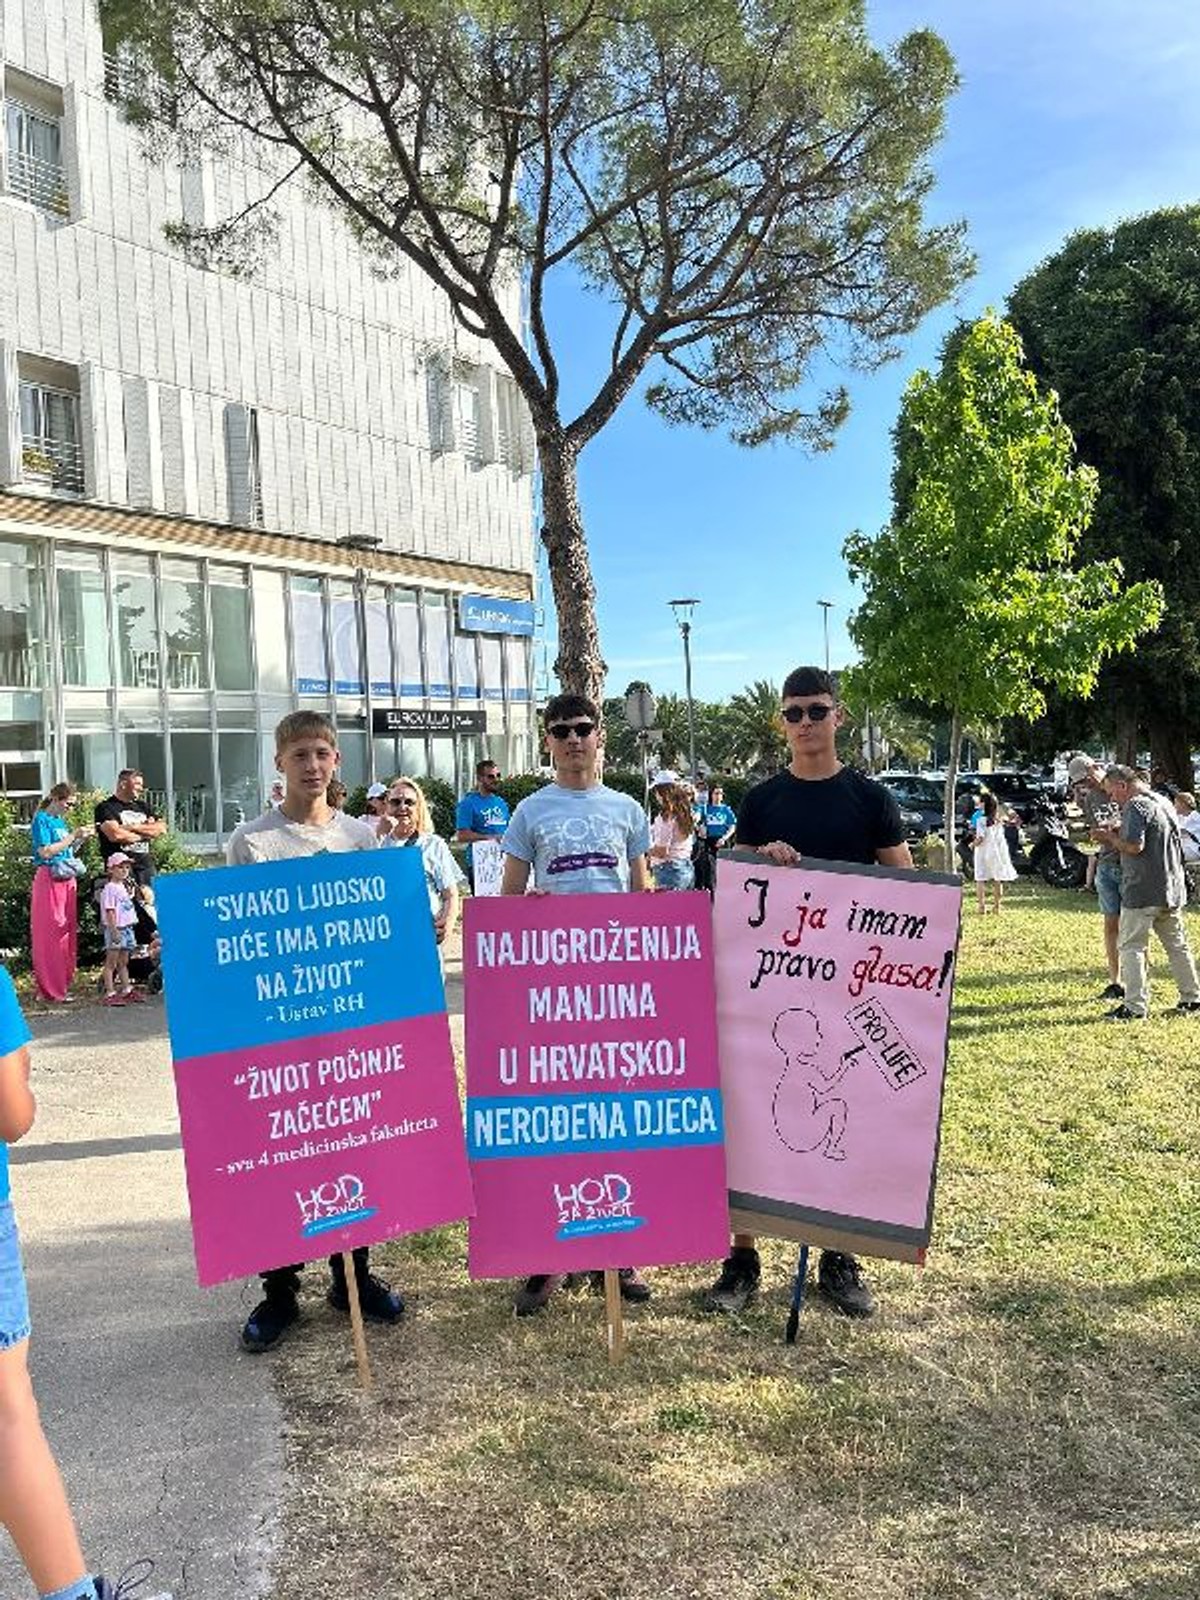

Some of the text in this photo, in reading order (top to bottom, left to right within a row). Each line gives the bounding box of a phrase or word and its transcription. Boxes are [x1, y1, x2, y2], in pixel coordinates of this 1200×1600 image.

[297, 875, 386, 911] LJUDSKO
[216, 914, 391, 965] BIĆE IMA PRAVO
[782, 891, 828, 947] ja
[847, 900, 928, 940] imam
[476, 920, 702, 967] NAJUGROŽENIJA
[256, 972, 287, 1001] NA
[750, 945, 954, 998] pravo glasa!
[277, 1002, 330, 1023] Ustav
[333, 992, 365, 1014] RH
[528, 982, 658, 1024] MANJINA
[318, 1043, 405, 1086] POČINJE
[499, 1038, 687, 1085] U HRVATSKOJ
[854, 1005, 919, 1085] PRO-LIFE
[258, 1153, 269, 1167] 4
[272, 1132, 367, 1165] medicinska
[370, 1117, 438, 1142] fakulteta
[473, 1096, 718, 1148] NEROĐENA DJECA
[295, 1174, 364, 1214] HOD
[554, 1173, 631, 1211] HOD
